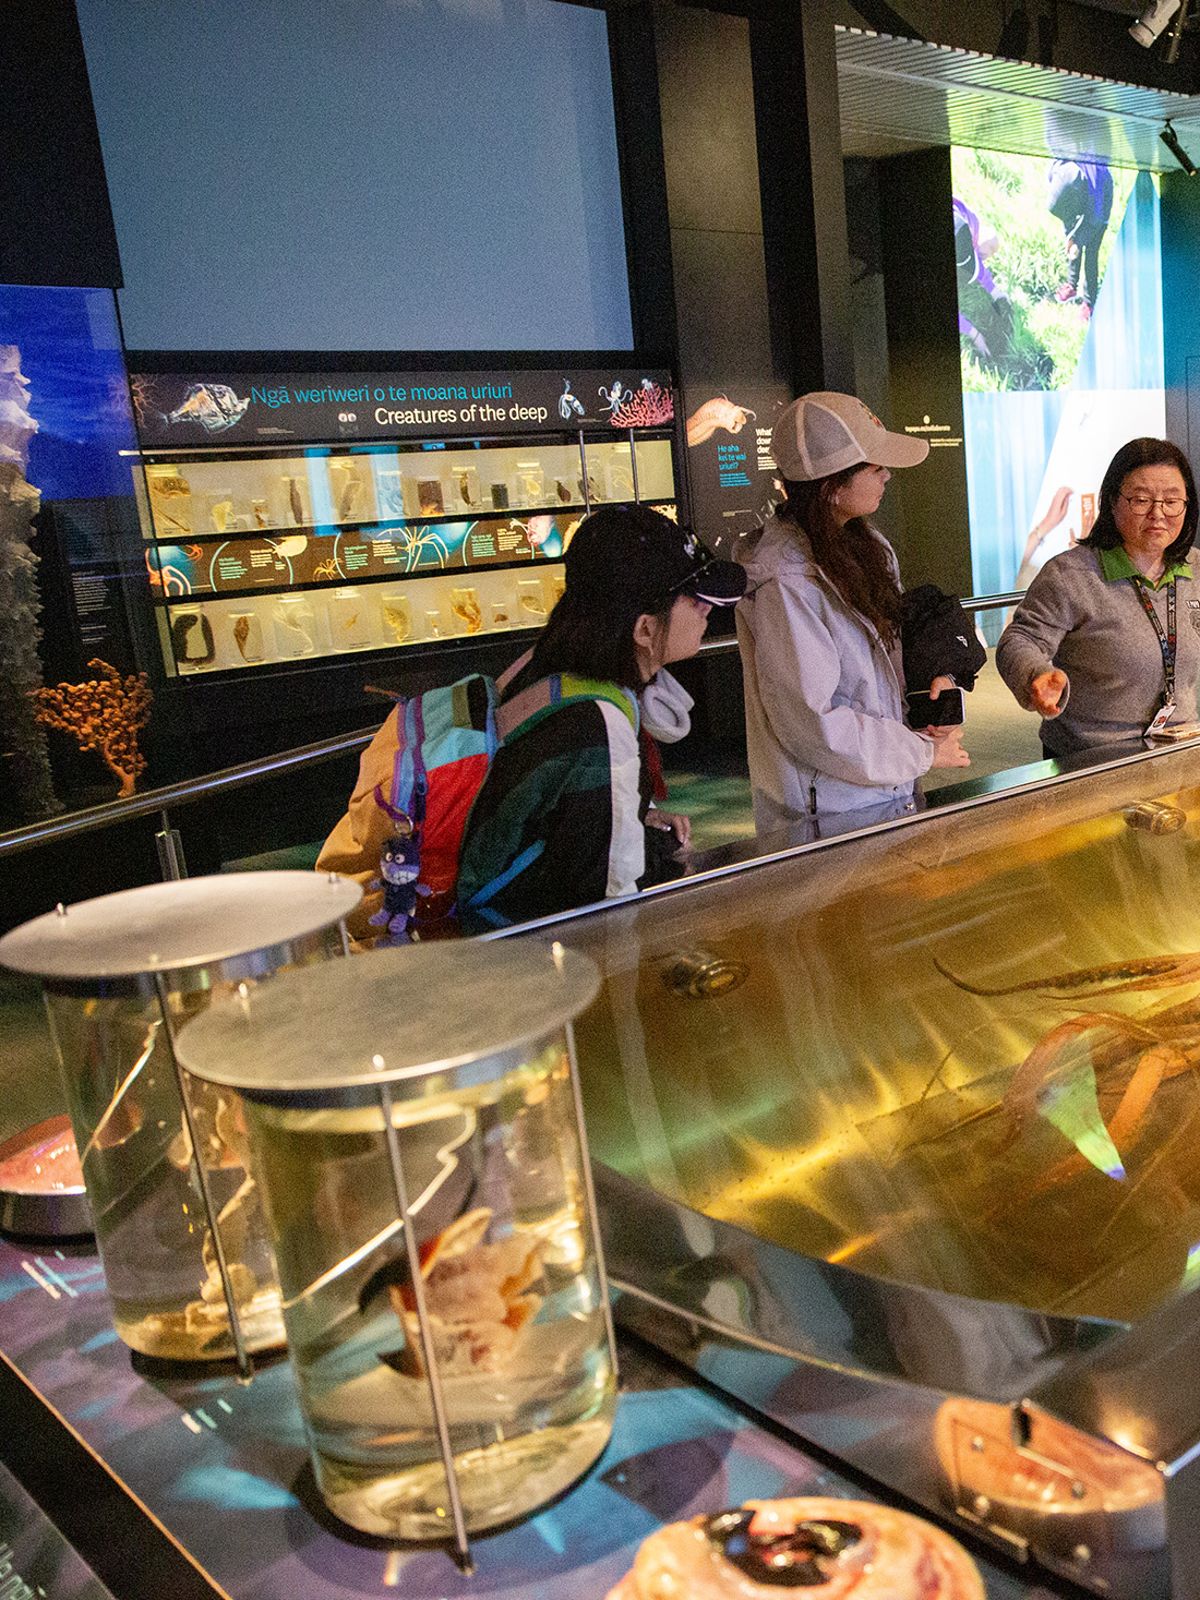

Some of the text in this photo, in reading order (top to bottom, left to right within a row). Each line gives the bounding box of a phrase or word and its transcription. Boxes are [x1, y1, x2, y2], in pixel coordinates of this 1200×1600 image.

[251, 382, 513, 408] Ngā weriweri o te moana uriuri
[374, 403, 548, 425] Creatures of the deep
